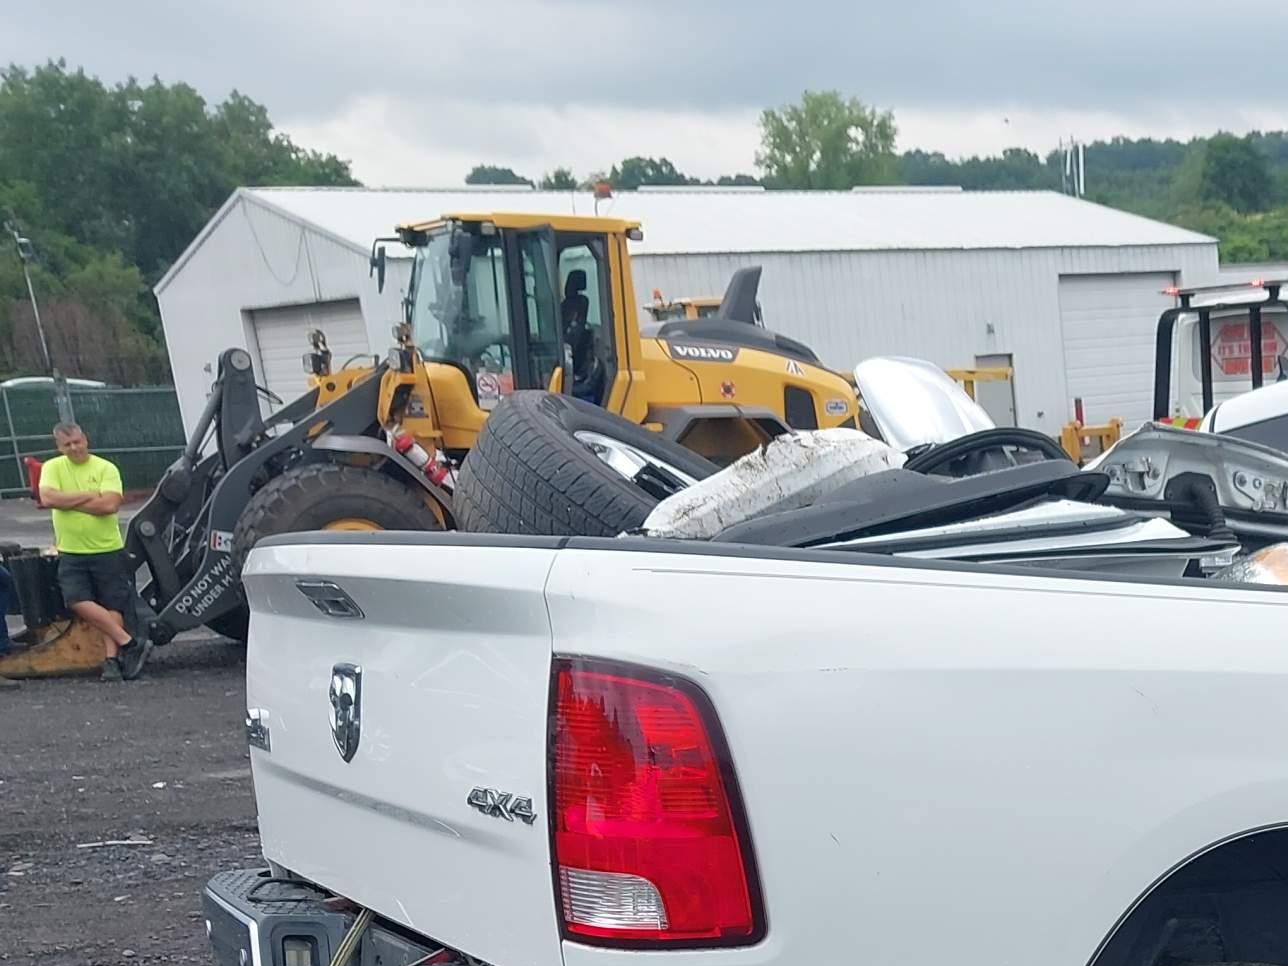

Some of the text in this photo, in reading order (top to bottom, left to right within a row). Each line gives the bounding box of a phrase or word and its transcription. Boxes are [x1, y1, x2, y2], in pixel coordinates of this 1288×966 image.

[673, 345, 733, 360] VOLVO
[175, 595, 193, 614] DO
[190, 573, 213, 599] NOT
[191, 584, 225, 617] UNDER
